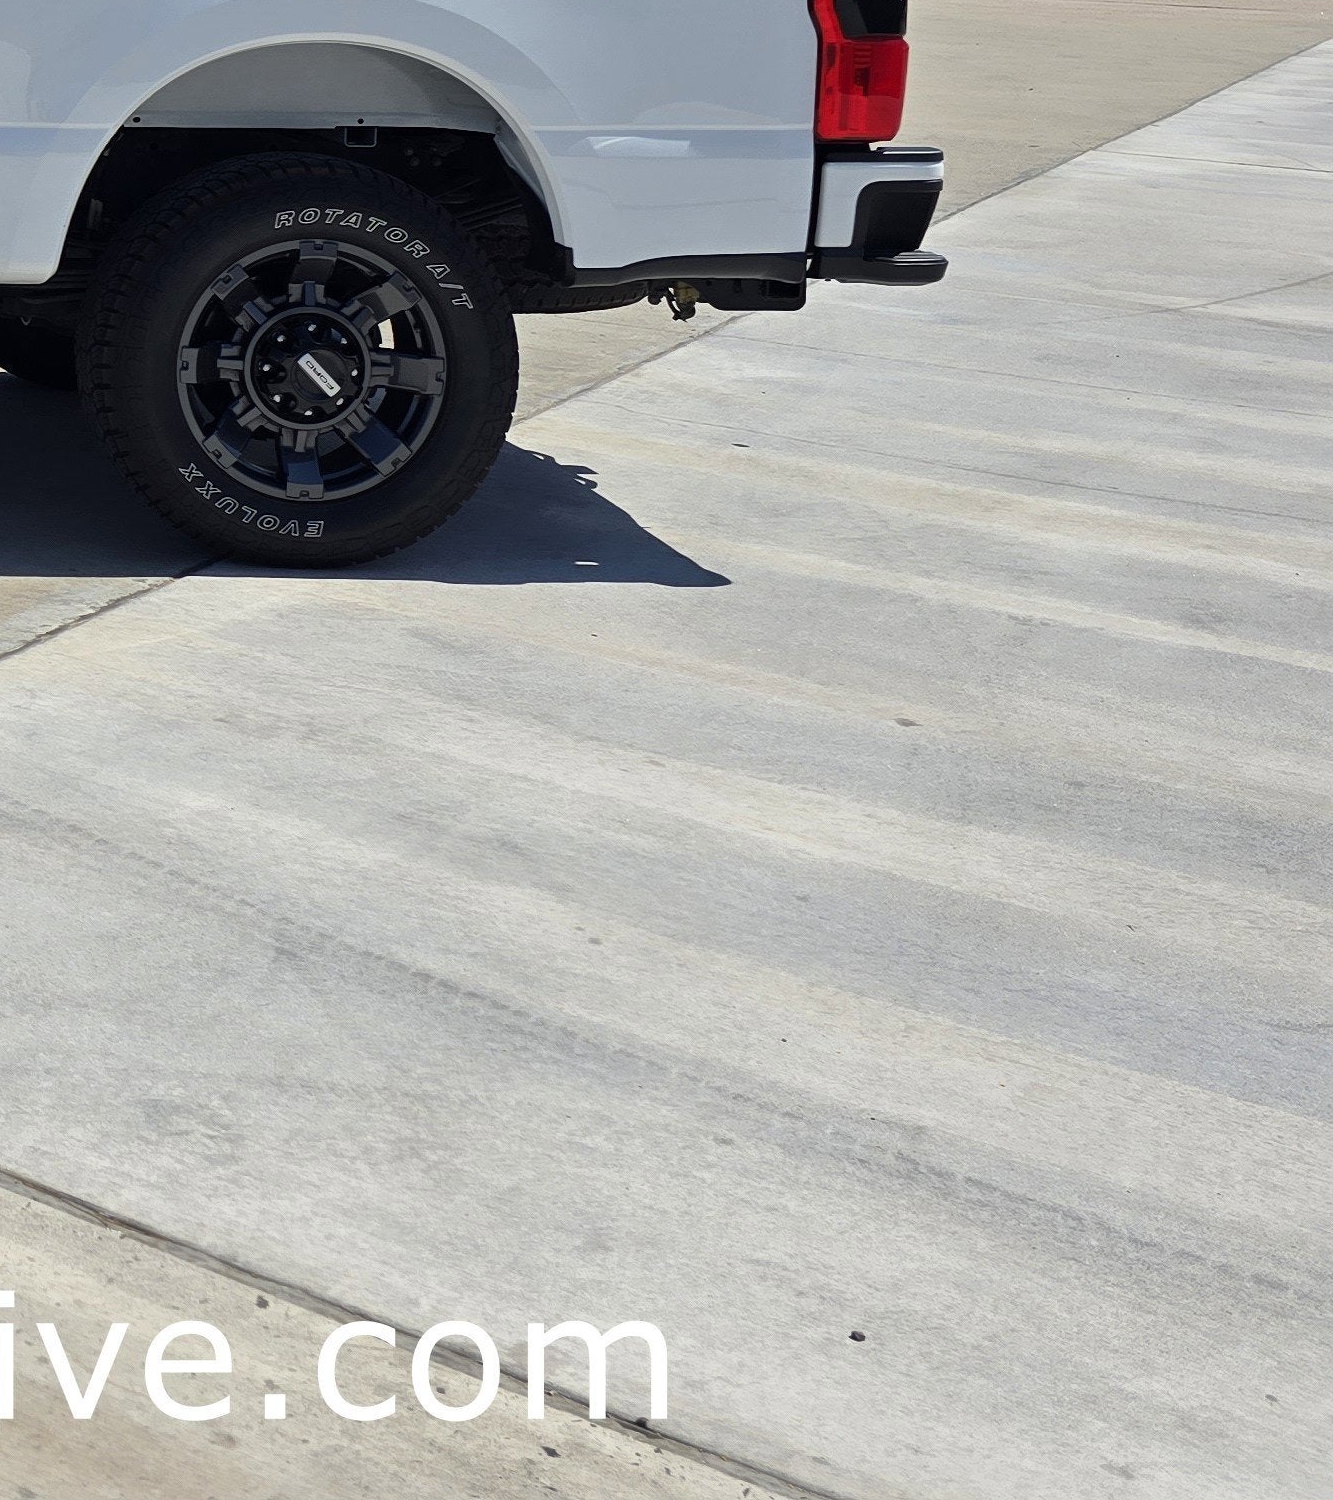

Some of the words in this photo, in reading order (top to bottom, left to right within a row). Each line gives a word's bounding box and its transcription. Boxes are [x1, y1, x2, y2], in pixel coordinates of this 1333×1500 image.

[274, 207, 432, 259] ROTATOR
[426, 262, 475, 311] A/T
[305, 360, 335, 391] FORD
[178, 461, 325, 539] EVOLUXX
